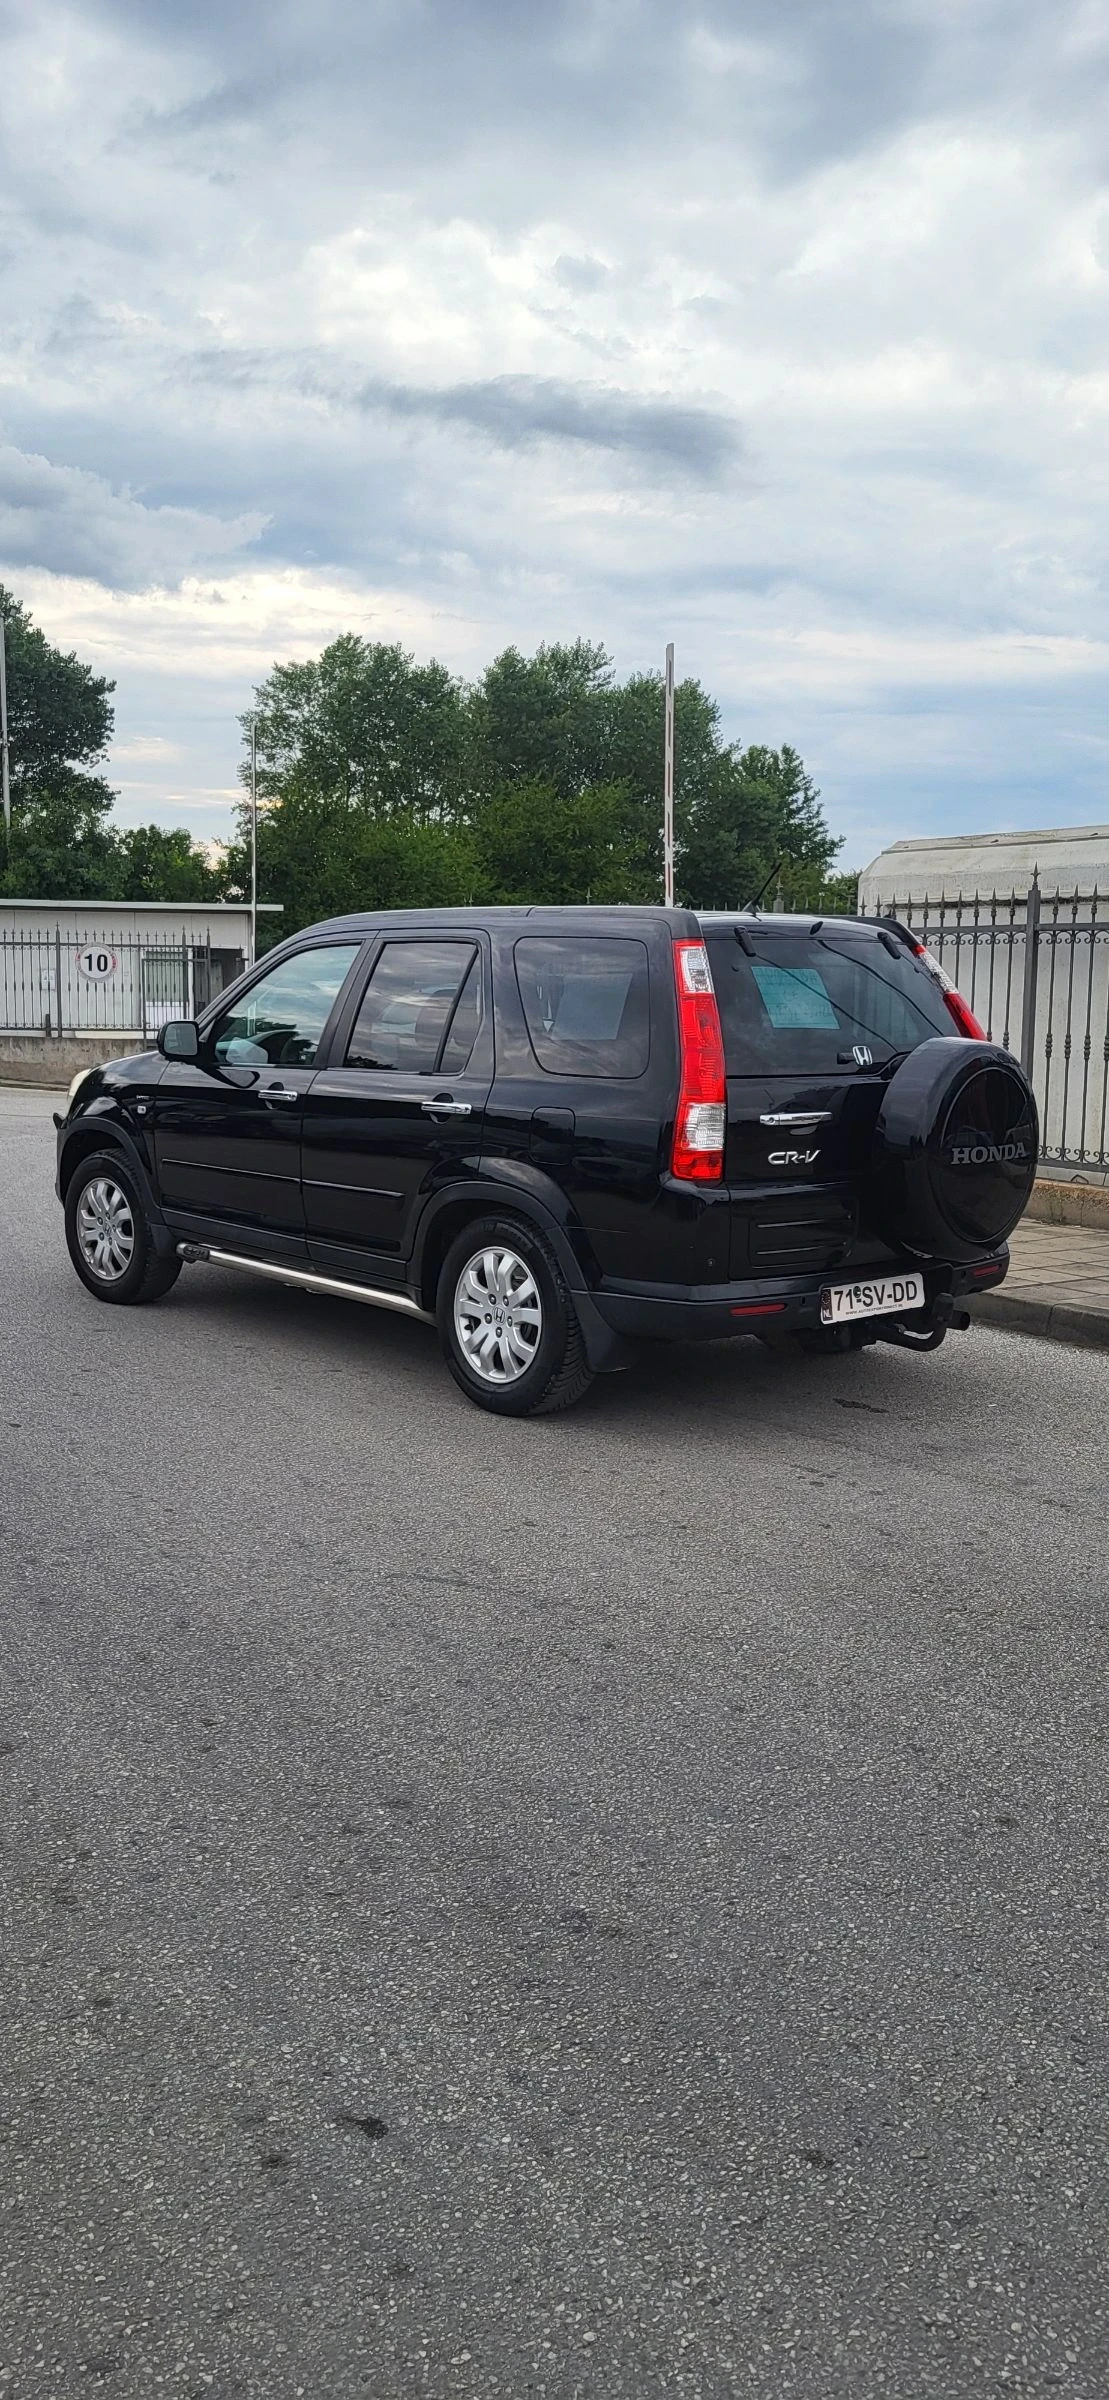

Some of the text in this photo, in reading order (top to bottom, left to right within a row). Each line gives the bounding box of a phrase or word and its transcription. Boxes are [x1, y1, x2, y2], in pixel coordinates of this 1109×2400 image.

[84, 953, 108, 972] 10
[768, 1149, 821, 1165] CR-V
[951, 1142, 1027, 1165] HONDA
[833, 1281, 917, 1312] 71-SV-DD
[822, 1308, 832, 1318] NL
